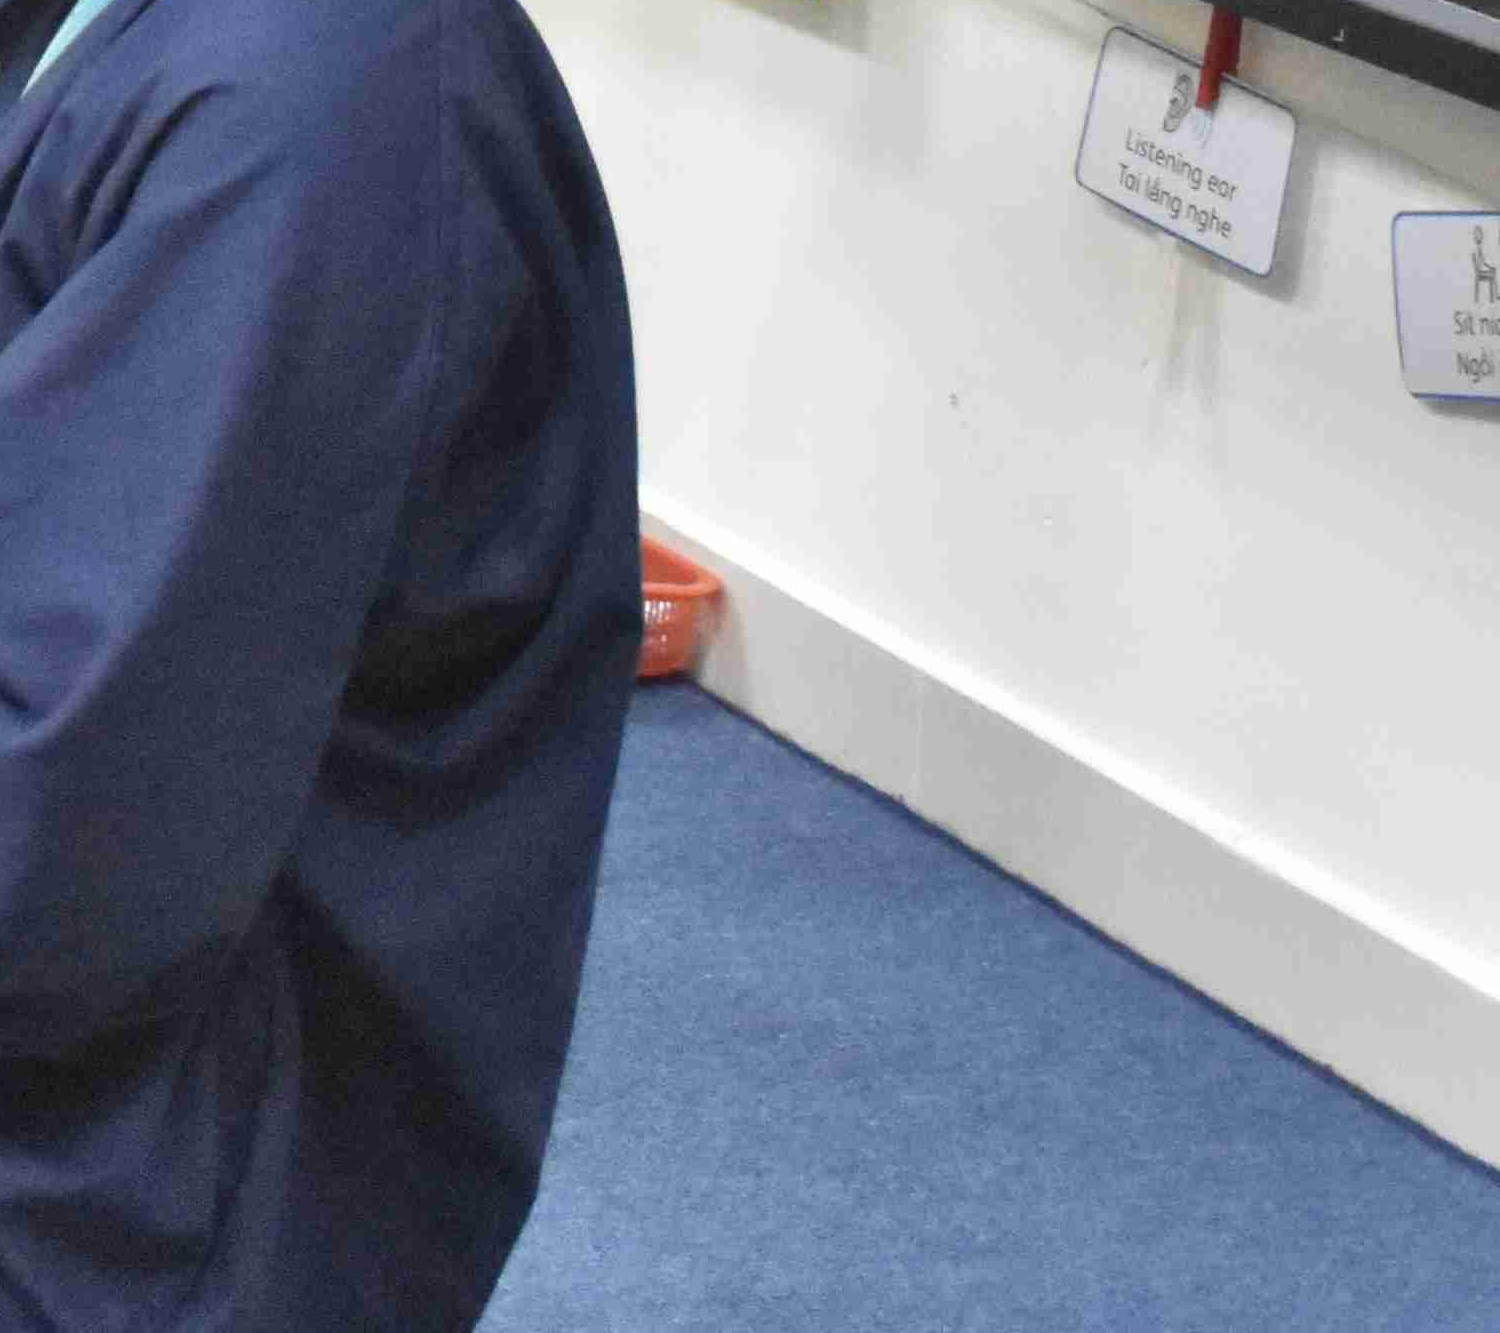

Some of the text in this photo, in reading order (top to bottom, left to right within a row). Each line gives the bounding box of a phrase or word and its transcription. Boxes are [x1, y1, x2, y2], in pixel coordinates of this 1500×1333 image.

[1118, 162, 1141, 193] Tai
[1185, 203, 1233, 238] nghe
[1125, 124, 1238, 202] Listening ear
